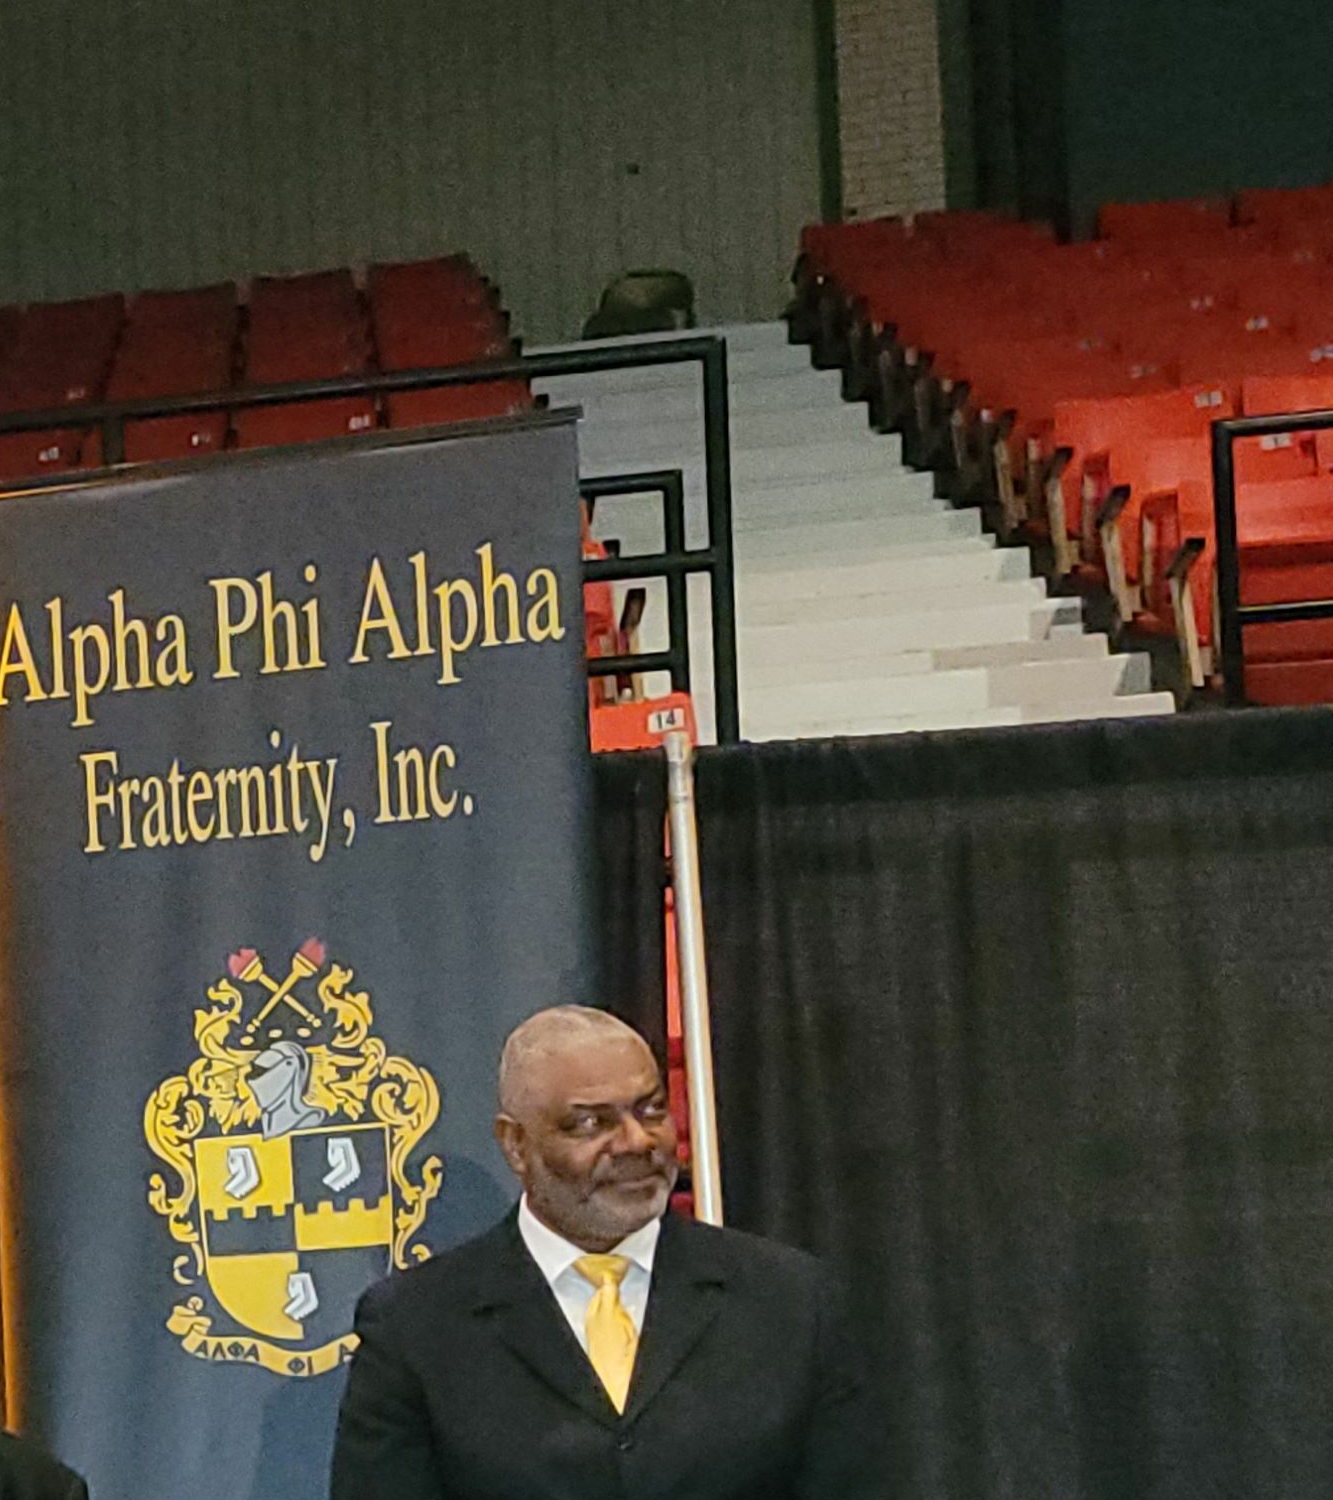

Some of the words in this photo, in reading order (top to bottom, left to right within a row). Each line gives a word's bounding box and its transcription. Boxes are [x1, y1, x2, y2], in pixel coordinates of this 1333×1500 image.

[208, 565, 328, 679] Phi
[348, 542, 566, 686] Alpha
[656, 709, 676, 730] 14
[79, 730, 357, 862] Fraternity,
[368, 721, 475, 825] Inc.
